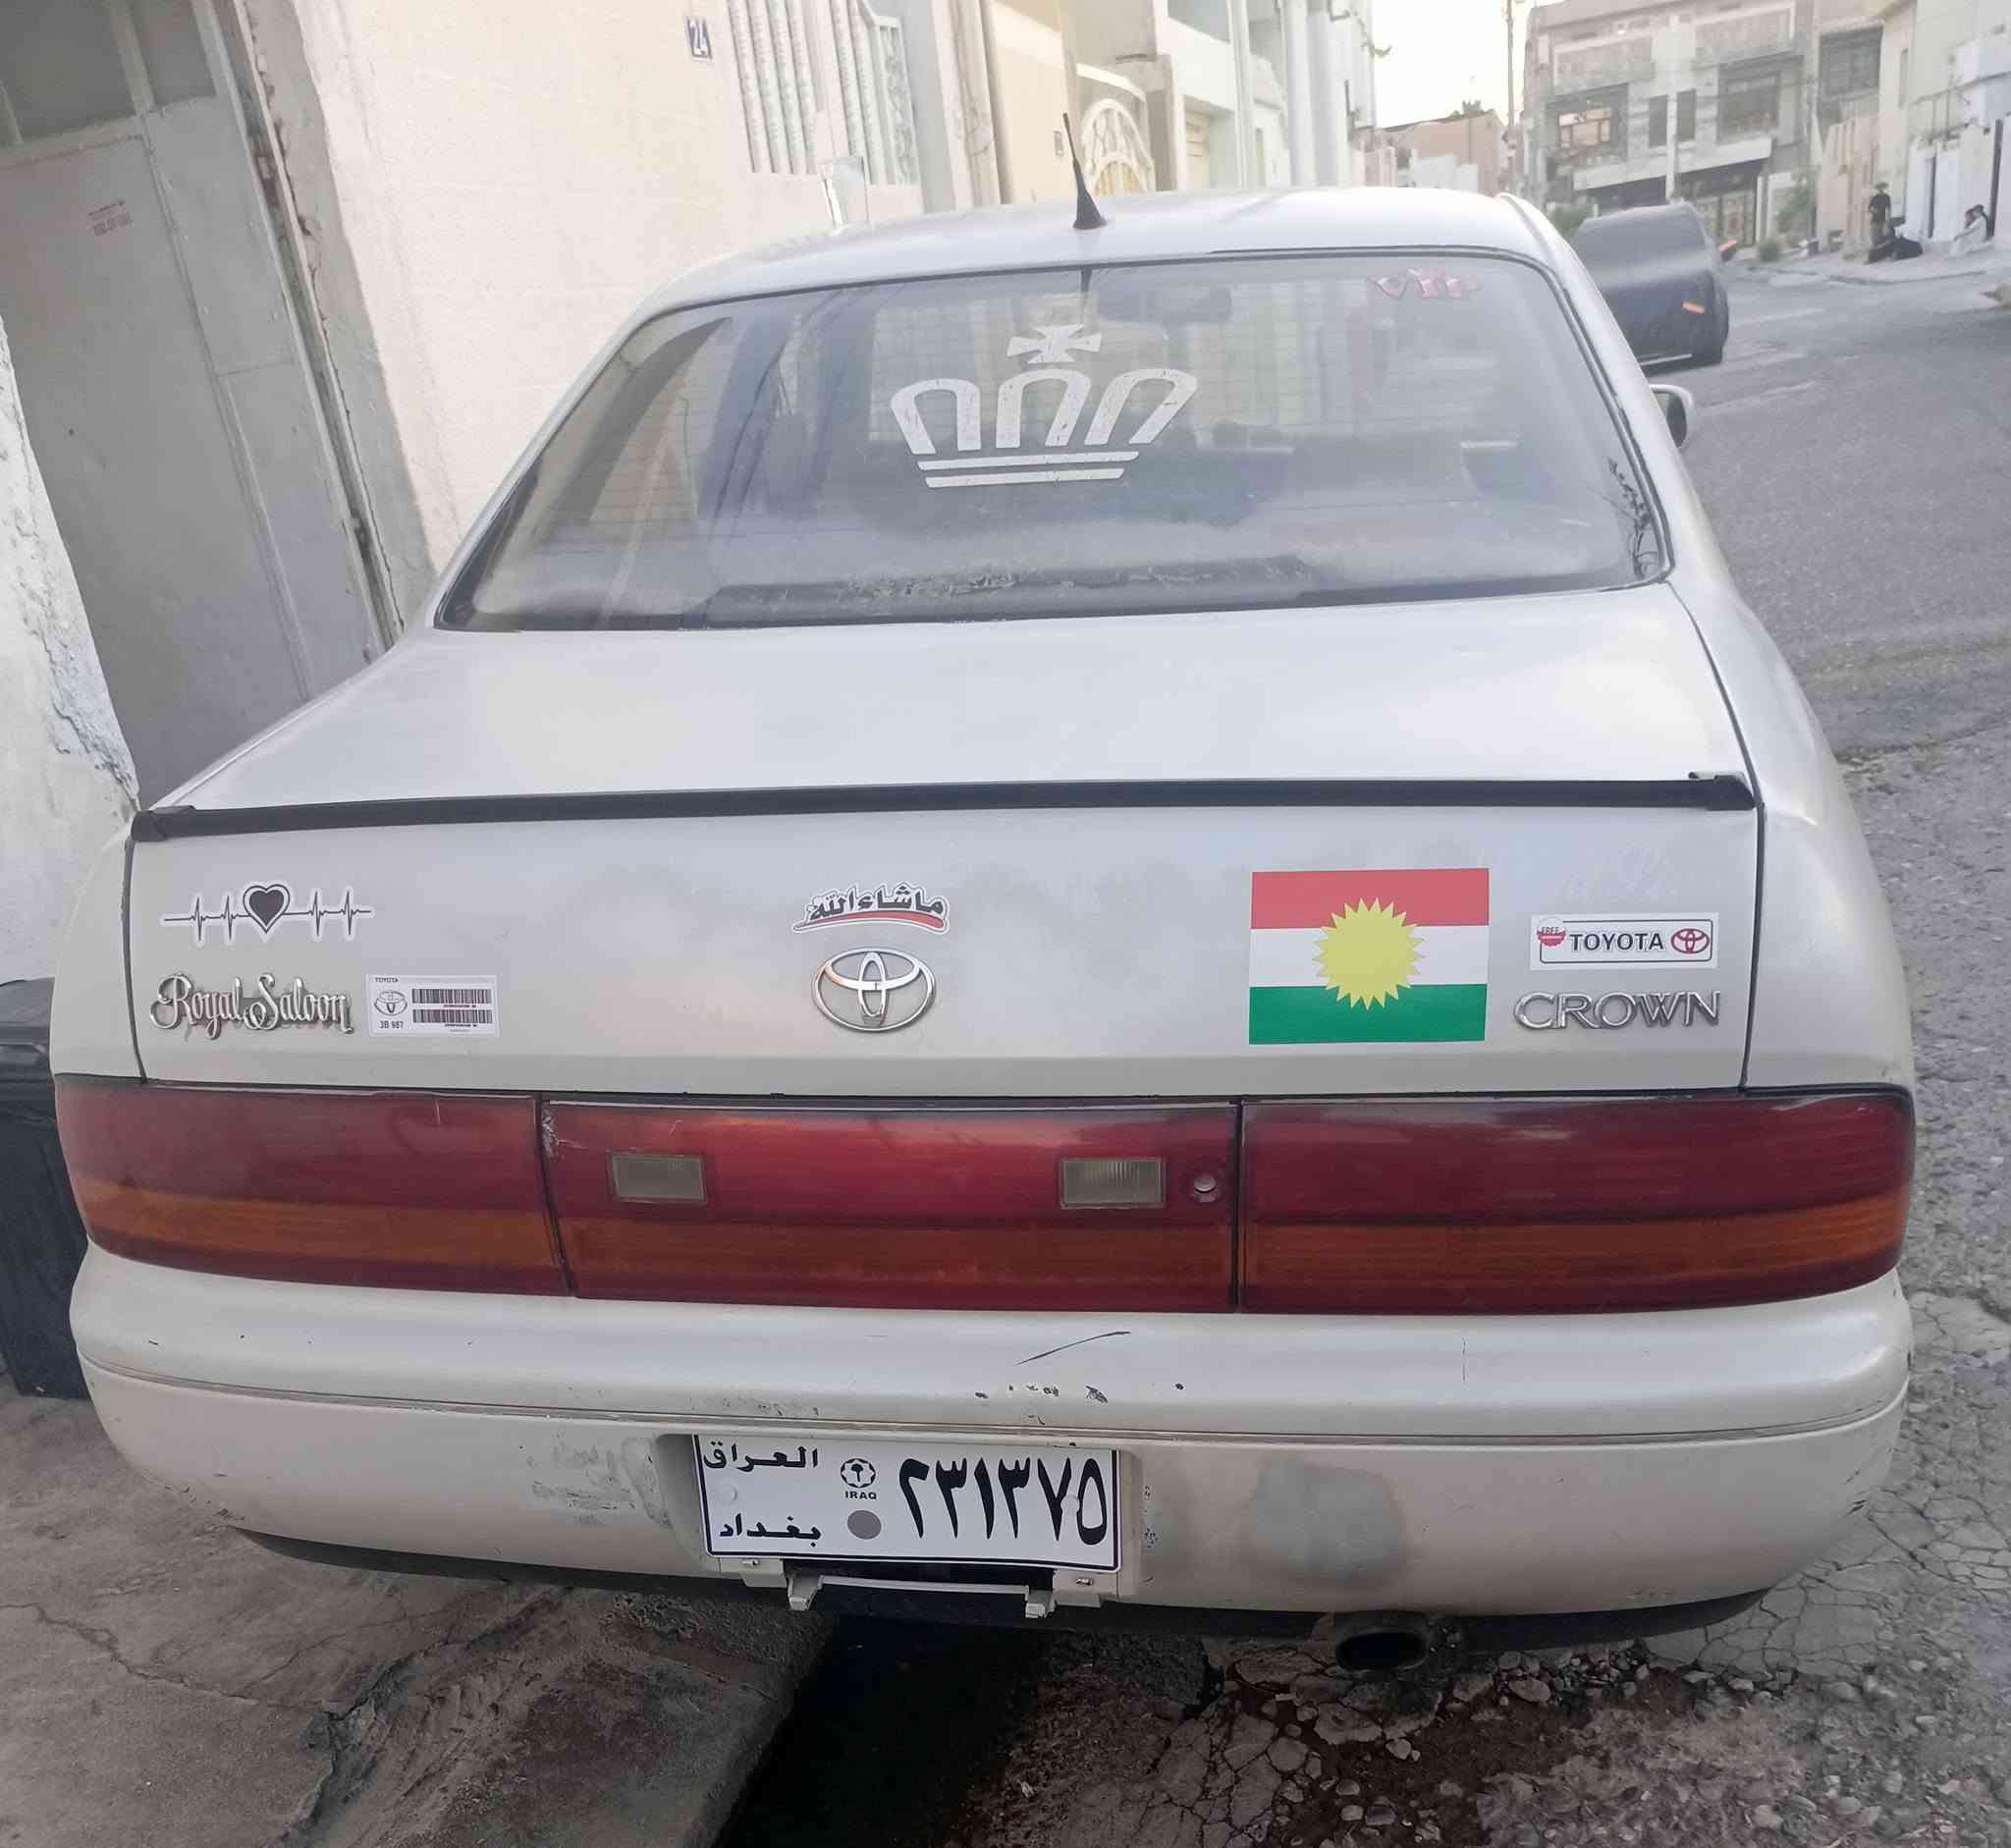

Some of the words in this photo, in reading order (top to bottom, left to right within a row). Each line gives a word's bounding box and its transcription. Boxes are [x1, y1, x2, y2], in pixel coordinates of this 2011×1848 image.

[1569, 932, 1664, 951] TOYOTA
[149, 972, 244, 1041] Royal
[244, 973, 354, 1035] Saloon
[1514, 991, 1721, 1029] CROWN
[703, 1440, 819, 1473] العراق
[844, 1491, 877, 1500] IRAQ
[898, 1457, 1108, 1547] ٢٣١٣٧٥
[719, 1512, 822, 1548] بغداد
